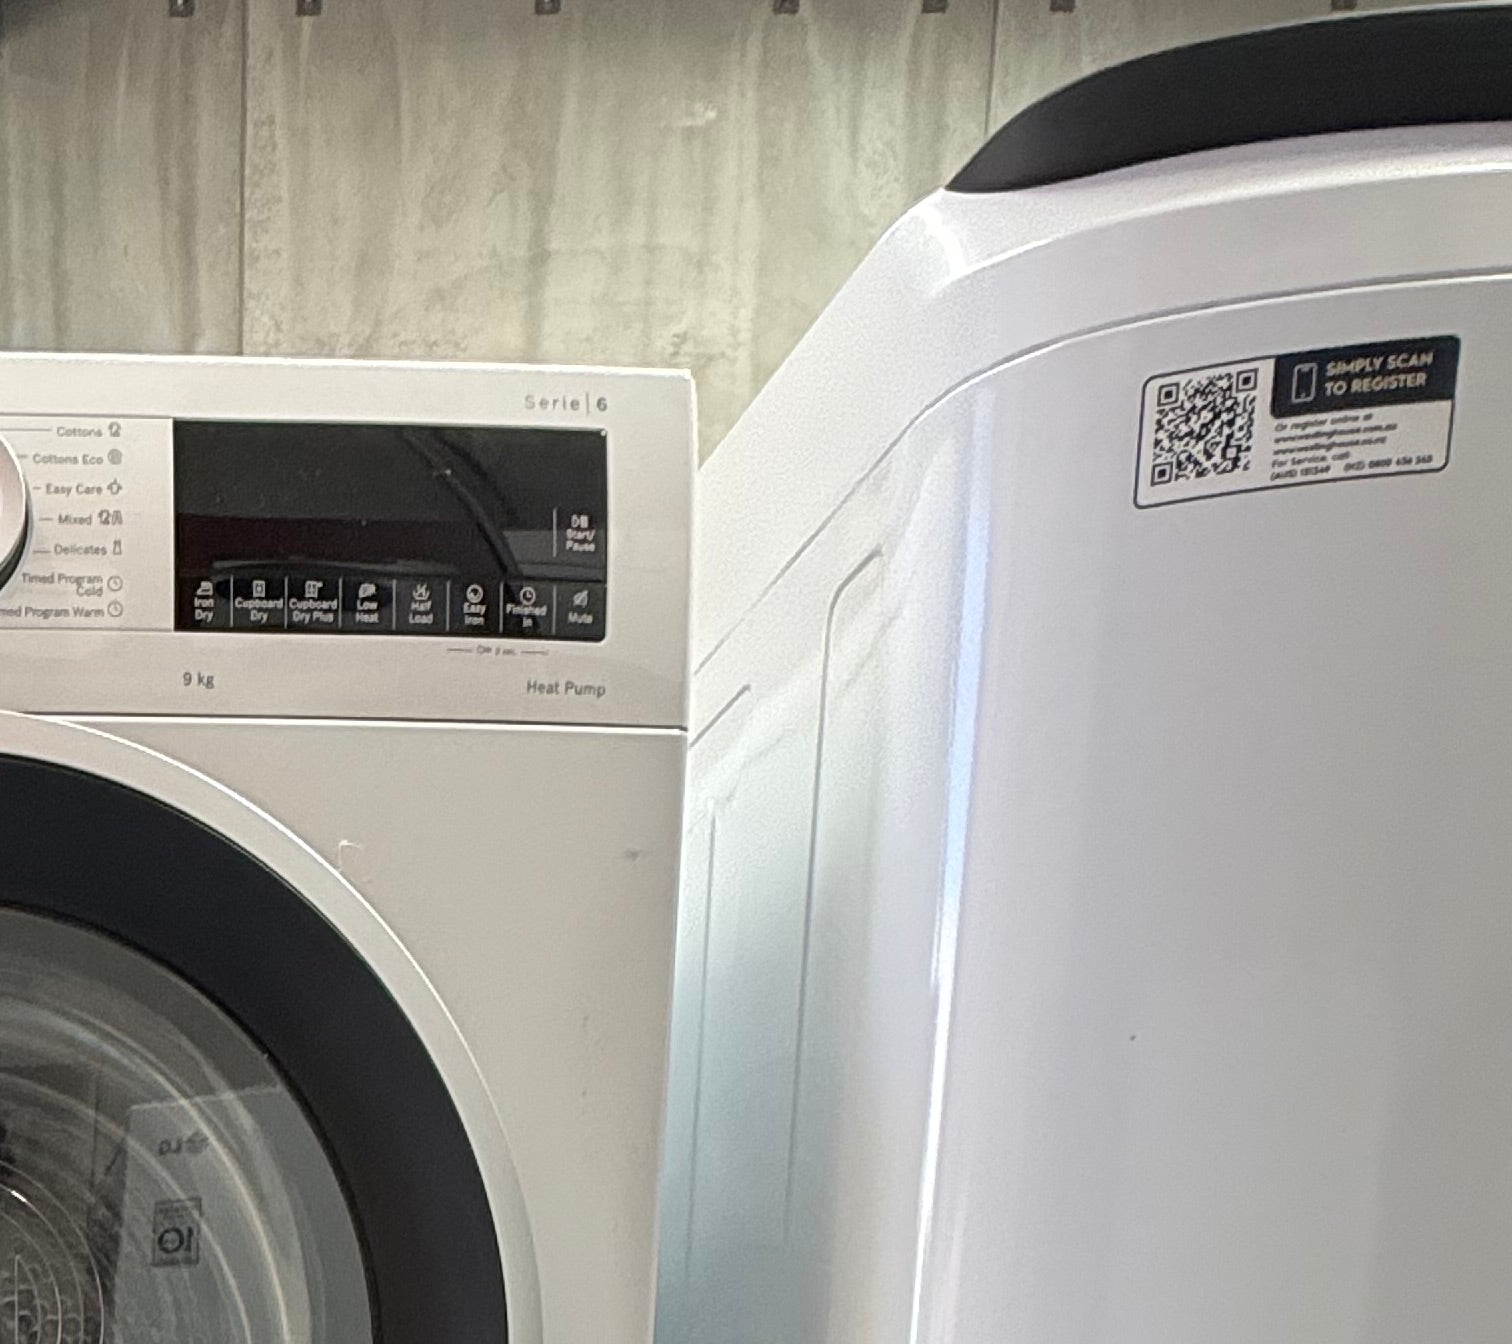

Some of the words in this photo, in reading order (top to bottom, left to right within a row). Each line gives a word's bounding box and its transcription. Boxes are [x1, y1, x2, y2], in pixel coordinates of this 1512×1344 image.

[1326, 356, 1384, 377] SIMPLY
[1387, 352, 1434, 370] SCAN
[1325, 381, 1348, 397] TO
[1350, 372, 1428, 393] REGISTER
[525, 395, 581, 411] Serie
[596, 396, 608, 412] 6
[57, 426, 103, 438] Cottons
[33, 453, 78, 465] Cottons
[82, 454, 103, 465] Eco
[46, 483, 72, 496] Easy
[76, 483, 103, 494] Care
[58, 513, 92, 525] Mixed
[54, 543, 107, 555] Delicates
[22, 573, 55, 584] Timed
[58, 573, 103, 588] Program
[194, 597, 215, 608] Iron
[289, 598, 338, 611] Cupboard
[356, 601, 378, 612] Low
[73, 606, 105, 617] Warm
[195, 609, 215, 622] Dry
[250, 611, 269, 623] Dry
[355, 612, 379, 623] Heat
[292, 612, 311, 624] Dry
[409, 612, 433, 624] Load
[183, 672, 192, 687] 9
[197, 671, 215, 689] kg
[526, 680, 560, 695] Heat
[564, 681, 606, 698] Pump
